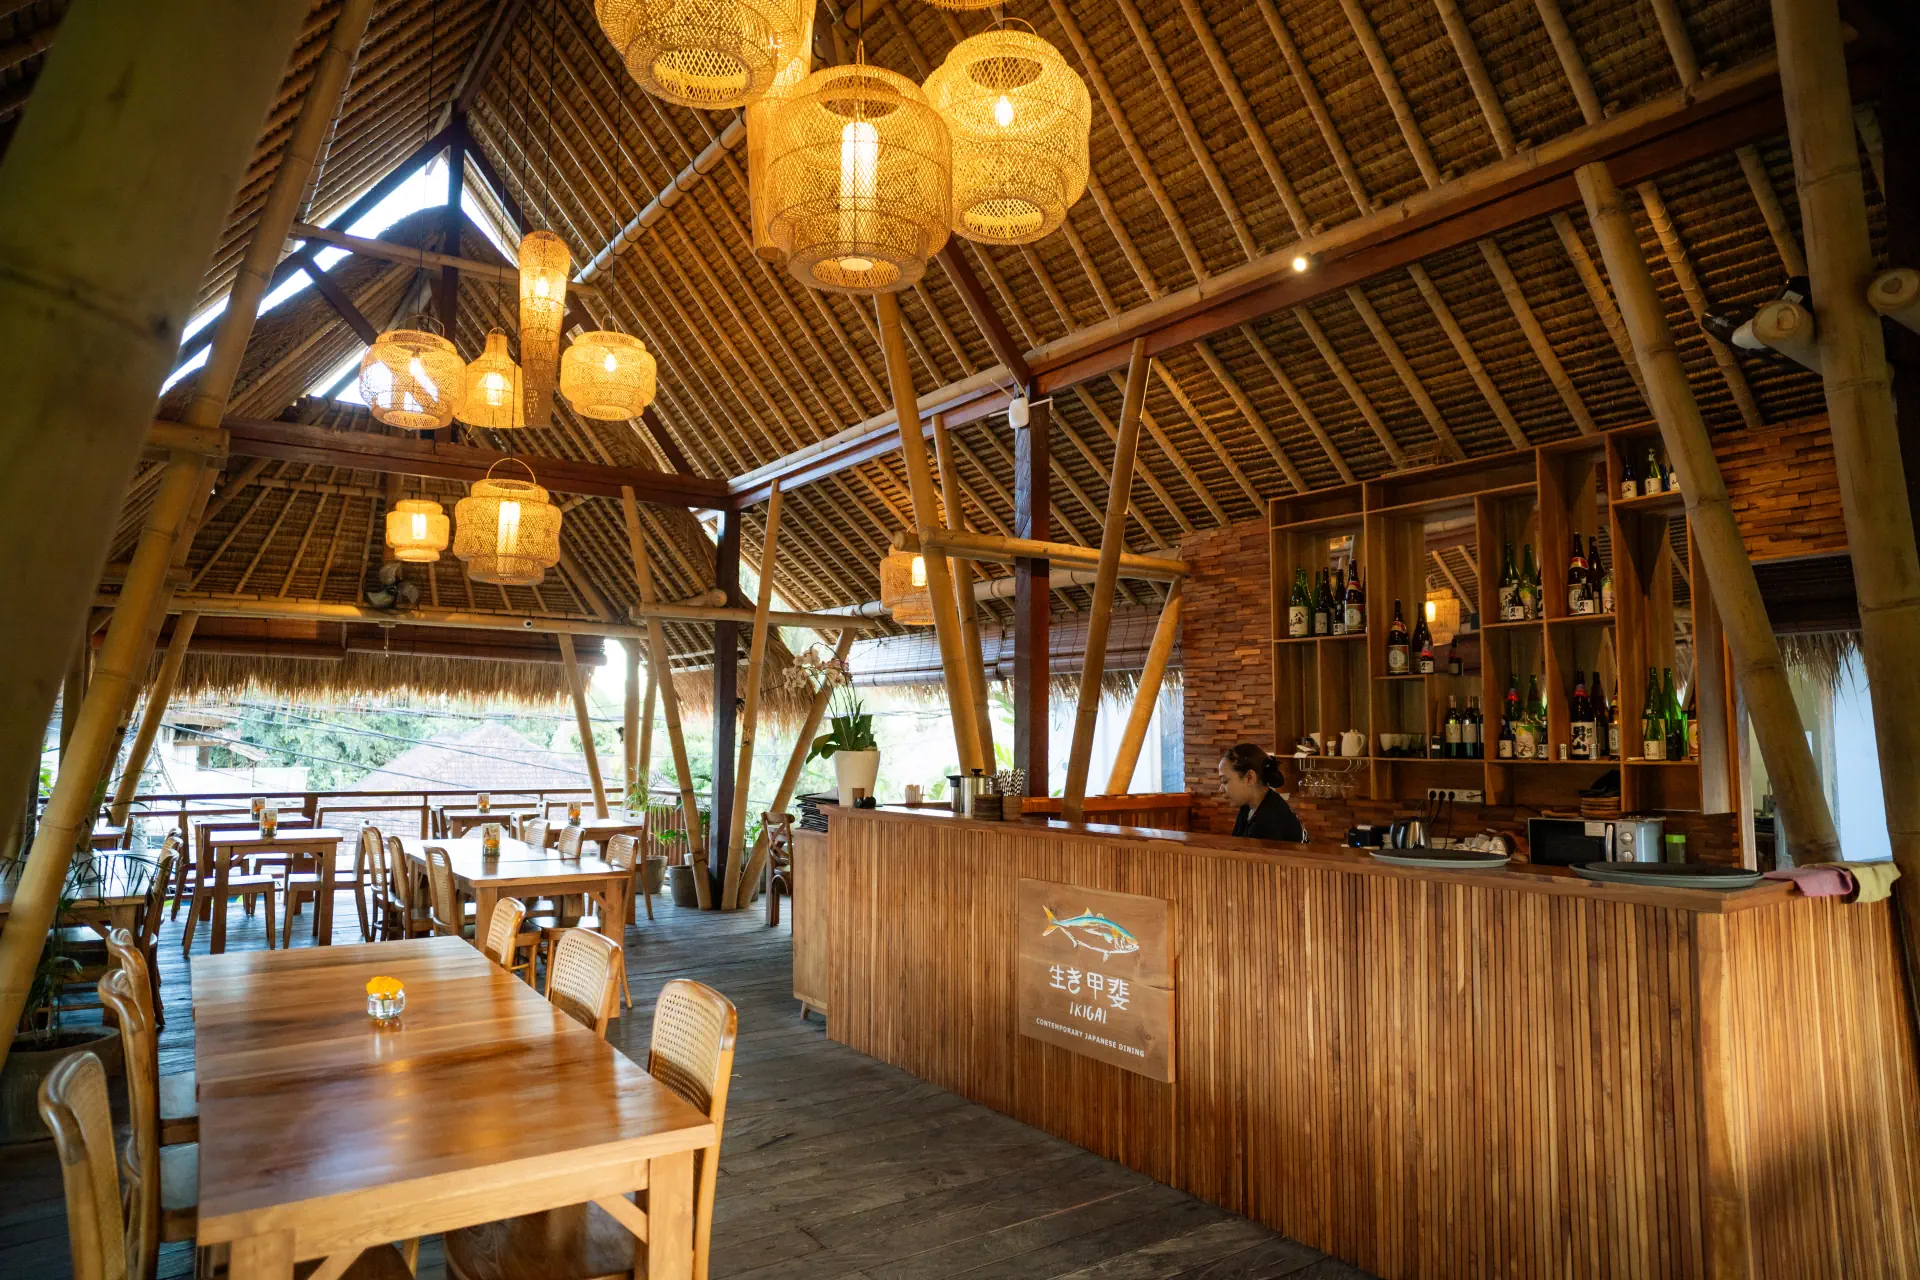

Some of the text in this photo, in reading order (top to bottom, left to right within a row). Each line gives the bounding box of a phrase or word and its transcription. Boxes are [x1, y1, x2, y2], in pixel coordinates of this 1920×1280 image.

[1049, 964, 1129, 1010] 生き甲斐
[1069, 1001, 1107, 1024] IKIGAI
[1036, 1017, 1145, 1058] CONTEMPORARY JAPANESE DINING
